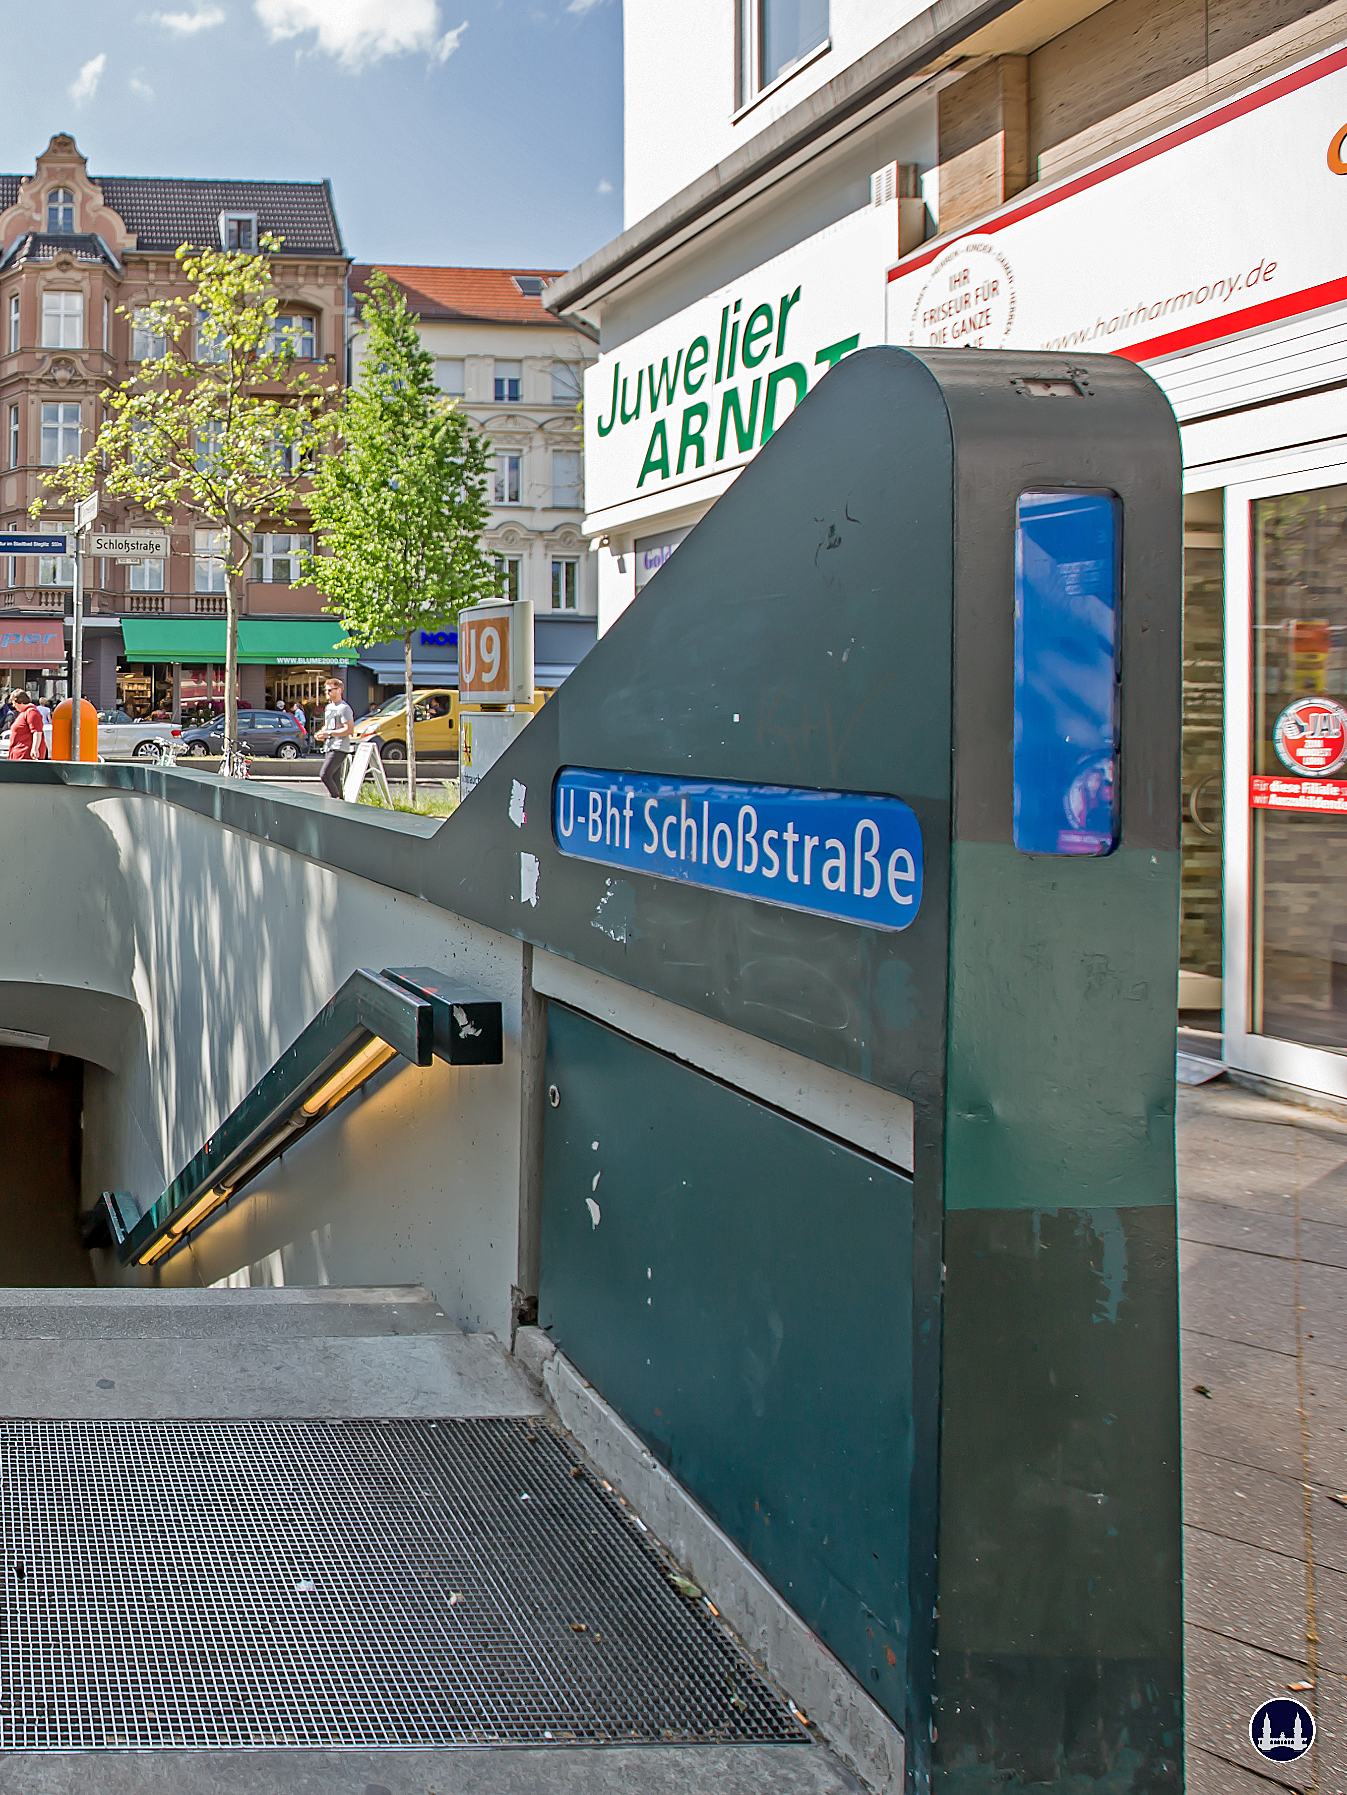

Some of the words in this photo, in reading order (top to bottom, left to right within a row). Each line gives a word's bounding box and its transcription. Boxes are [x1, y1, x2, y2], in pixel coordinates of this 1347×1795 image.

[949, 268, 970, 292] IHR
[923, 292, 971, 329] FRISEUR
[975, 279, 1000, 306] FÜR
[930, 326, 948, 346] DIE
[951, 308, 992, 340] GANZE
[597, 284, 802, 438] Juwelier
[96, 538, 161, 554] Schloßstraße
[276, 657, 350, 665] WWW.BLUME2000.DE
[461, 626, 501, 684] U9
[559, 788, 634, 849] U-Bhf
[643, 798, 915, 905] Schloßstraße
